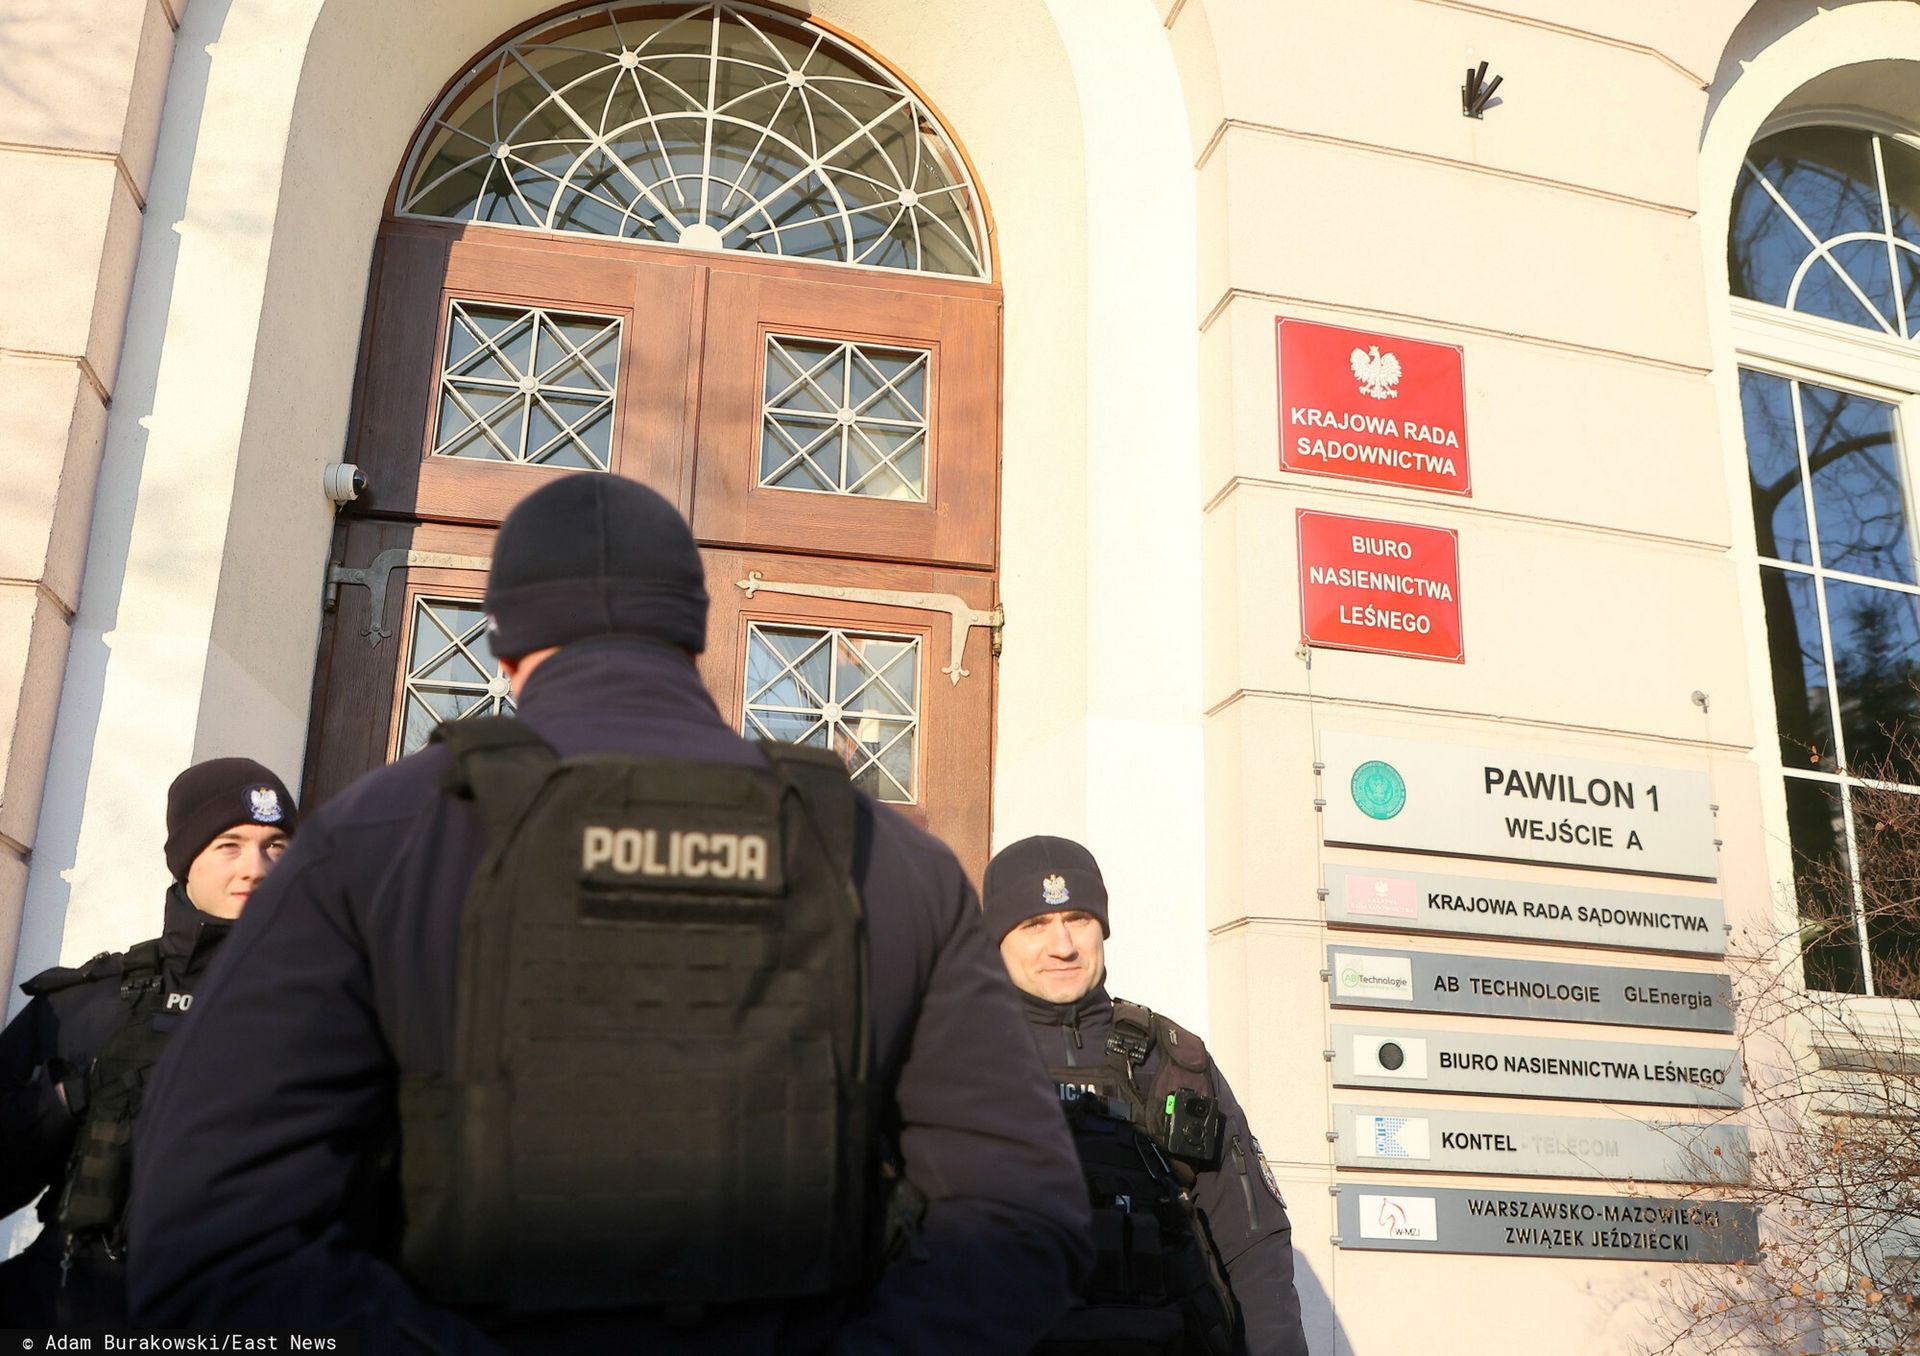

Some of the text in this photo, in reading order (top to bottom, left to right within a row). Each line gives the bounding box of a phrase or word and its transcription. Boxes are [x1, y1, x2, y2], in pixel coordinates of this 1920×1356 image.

[1291, 407, 1459, 448] KRAJOWA RADA
[1297, 437, 1456, 476] SĄDOWNICTWA
[1352, 535, 1412, 559] BIURO
[1310, 566, 1453, 602] NASIENNICTWA
[1340, 604, 1431, 634] LEŚNEGO
[1484, 766, 1660, 812] PAWILON 1
[1505, 817, 1643, 851] WEJŚCIE A
[583, 826, 768, 880] POLICJA
[1427, 893, 1518, 917] KRAJOWA
[1523, 901, 1572, 921] RADA
[1577, 905, 1709, 933] SĄDOWNICTWA
[1359, 974, 1408, 988] Technologie
[1434, 975, 1712, 1009] AB TECHNOLOGIE GLEnergia
[1440, 1051, 1726, 1085] BIURO NASIENNICTWA LEŚNEGO
[1442, 1132, 1517, 1151] KONTEL
[1505, 1227, 1689, 1251] ZWIĄZEK JEŹDZIECKI
